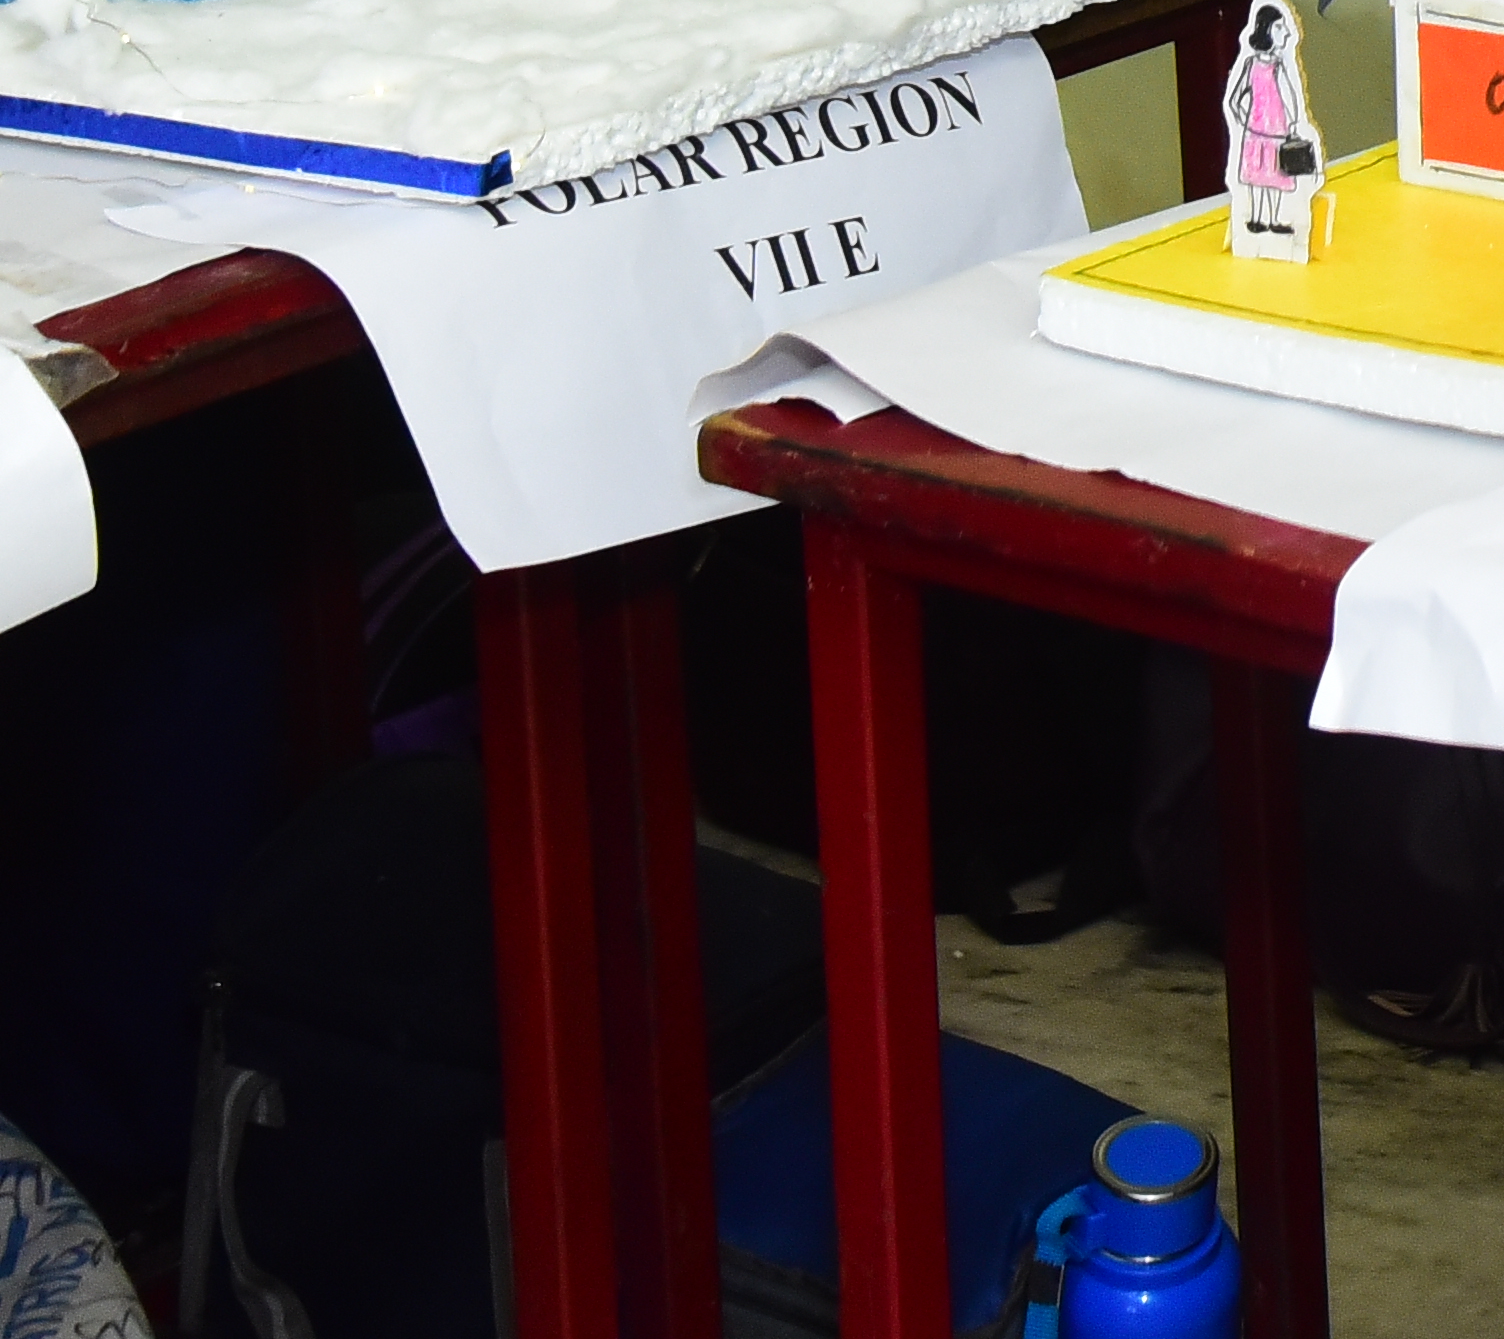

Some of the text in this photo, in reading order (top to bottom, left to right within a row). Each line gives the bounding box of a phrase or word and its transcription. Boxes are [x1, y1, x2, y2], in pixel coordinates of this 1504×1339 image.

[723, 72, 986, 174] REGION
[714, 216, 880, 302] VII E
